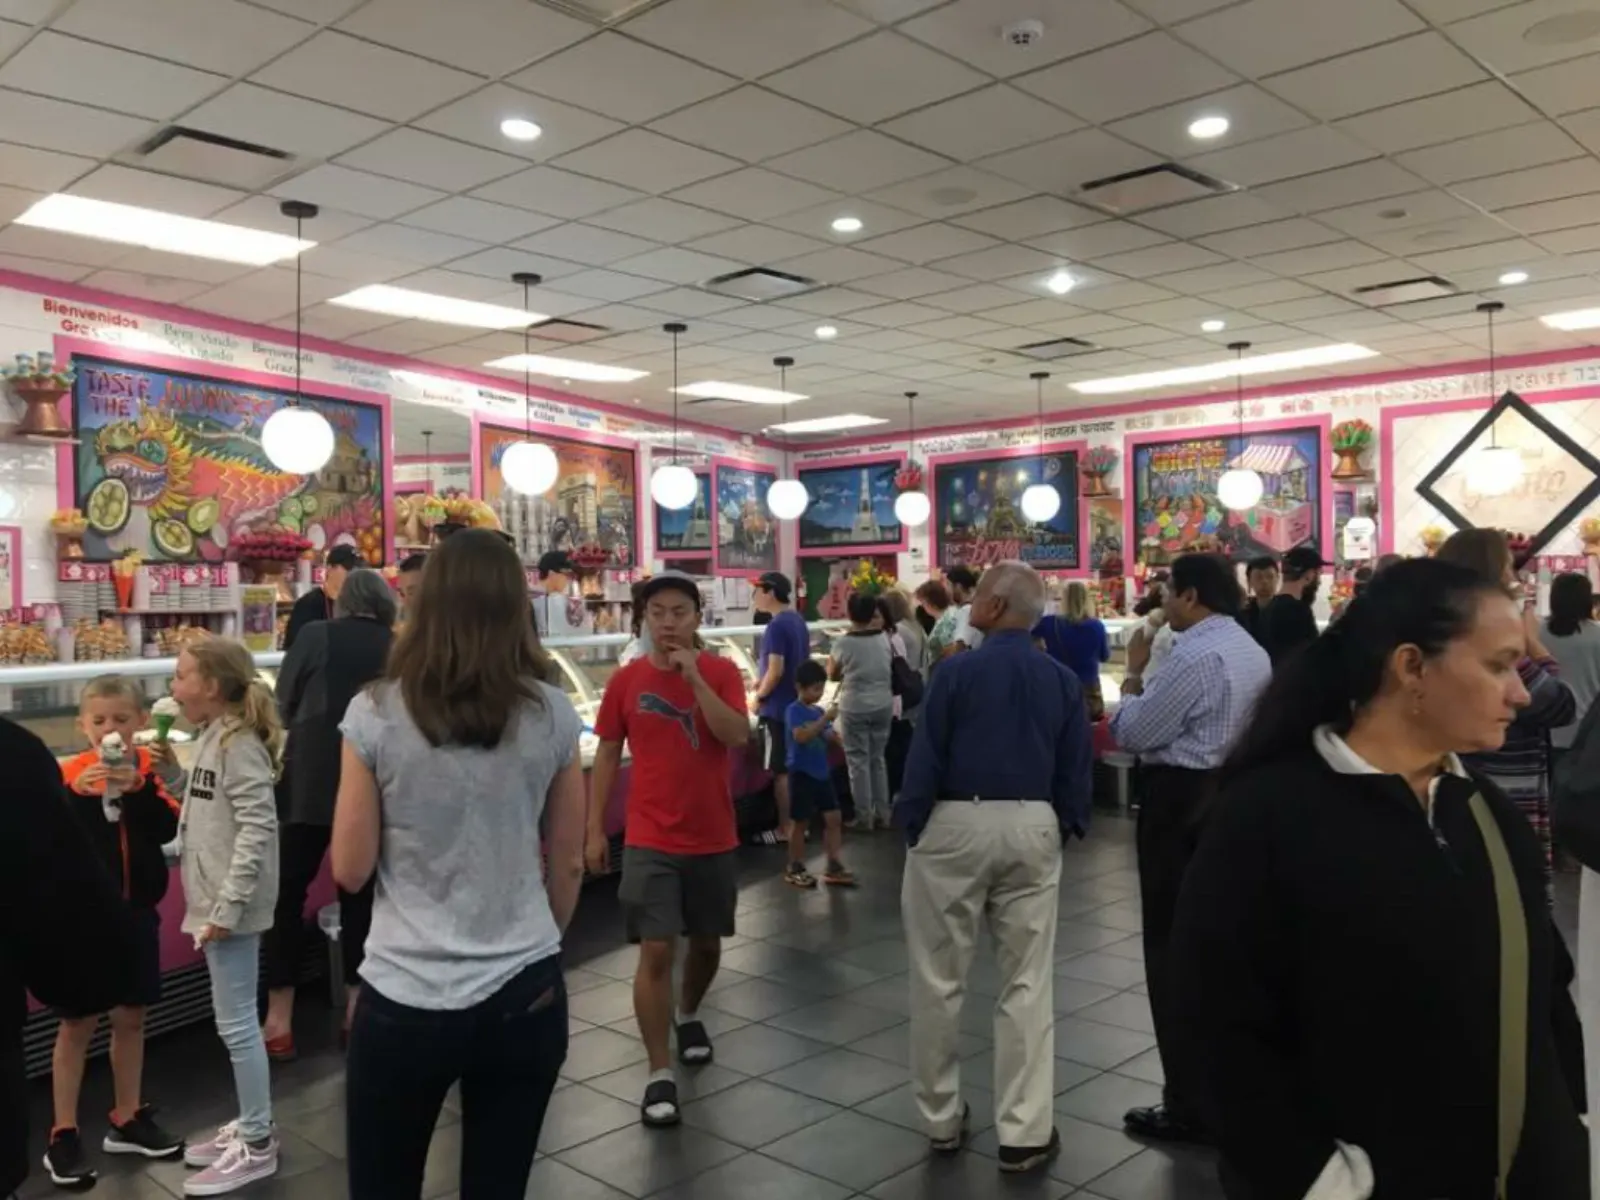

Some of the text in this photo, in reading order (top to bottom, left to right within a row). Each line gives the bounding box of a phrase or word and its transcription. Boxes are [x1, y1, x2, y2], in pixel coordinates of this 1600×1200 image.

[43, 298, 138, 330] Bienvenidos
[84, 368, 152, 400] TASTE
[91, 396, 131, 417] THE
